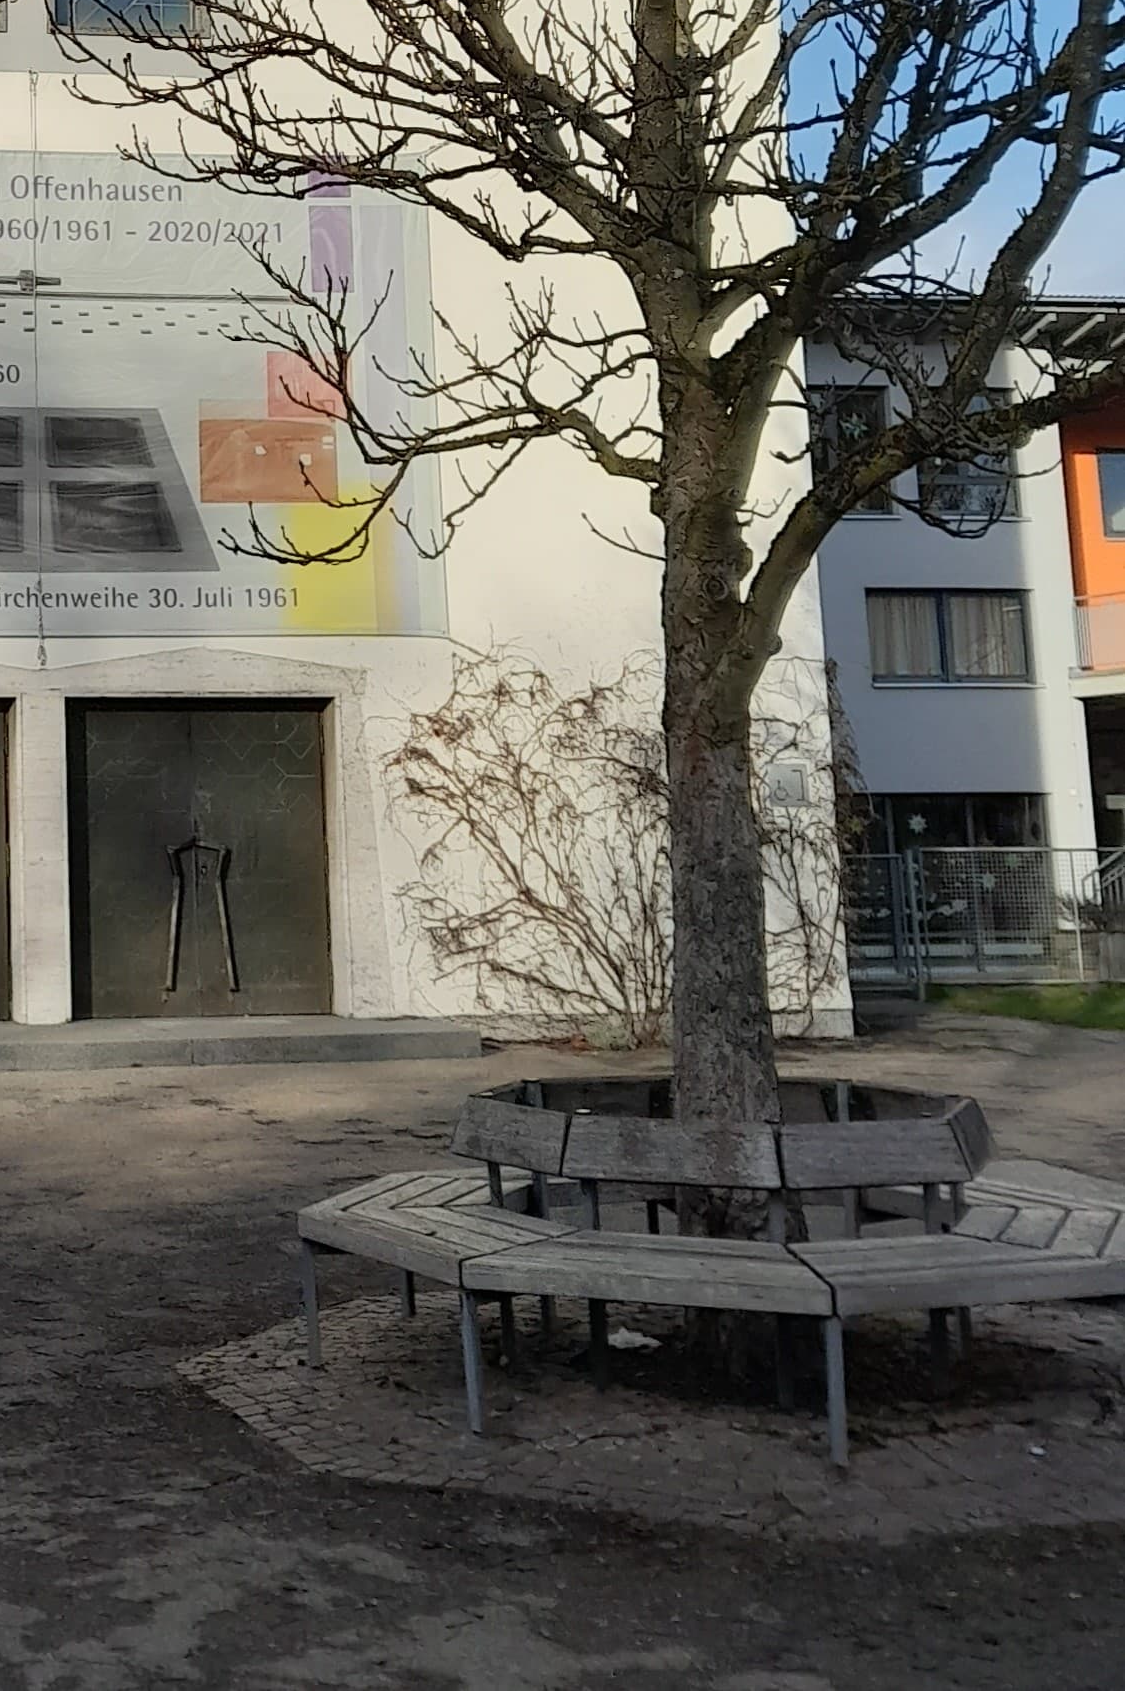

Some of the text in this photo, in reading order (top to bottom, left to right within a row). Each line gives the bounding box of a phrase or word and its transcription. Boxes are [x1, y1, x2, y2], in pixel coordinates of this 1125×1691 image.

[10, 174, 183, 202] Offenhausen
[147, 218, 283, 246] 2020/2021
[148, 587, 185, 609] 30.
[192, 585, 233, 609] Juli
[245, 587, 300, 608] 1961
